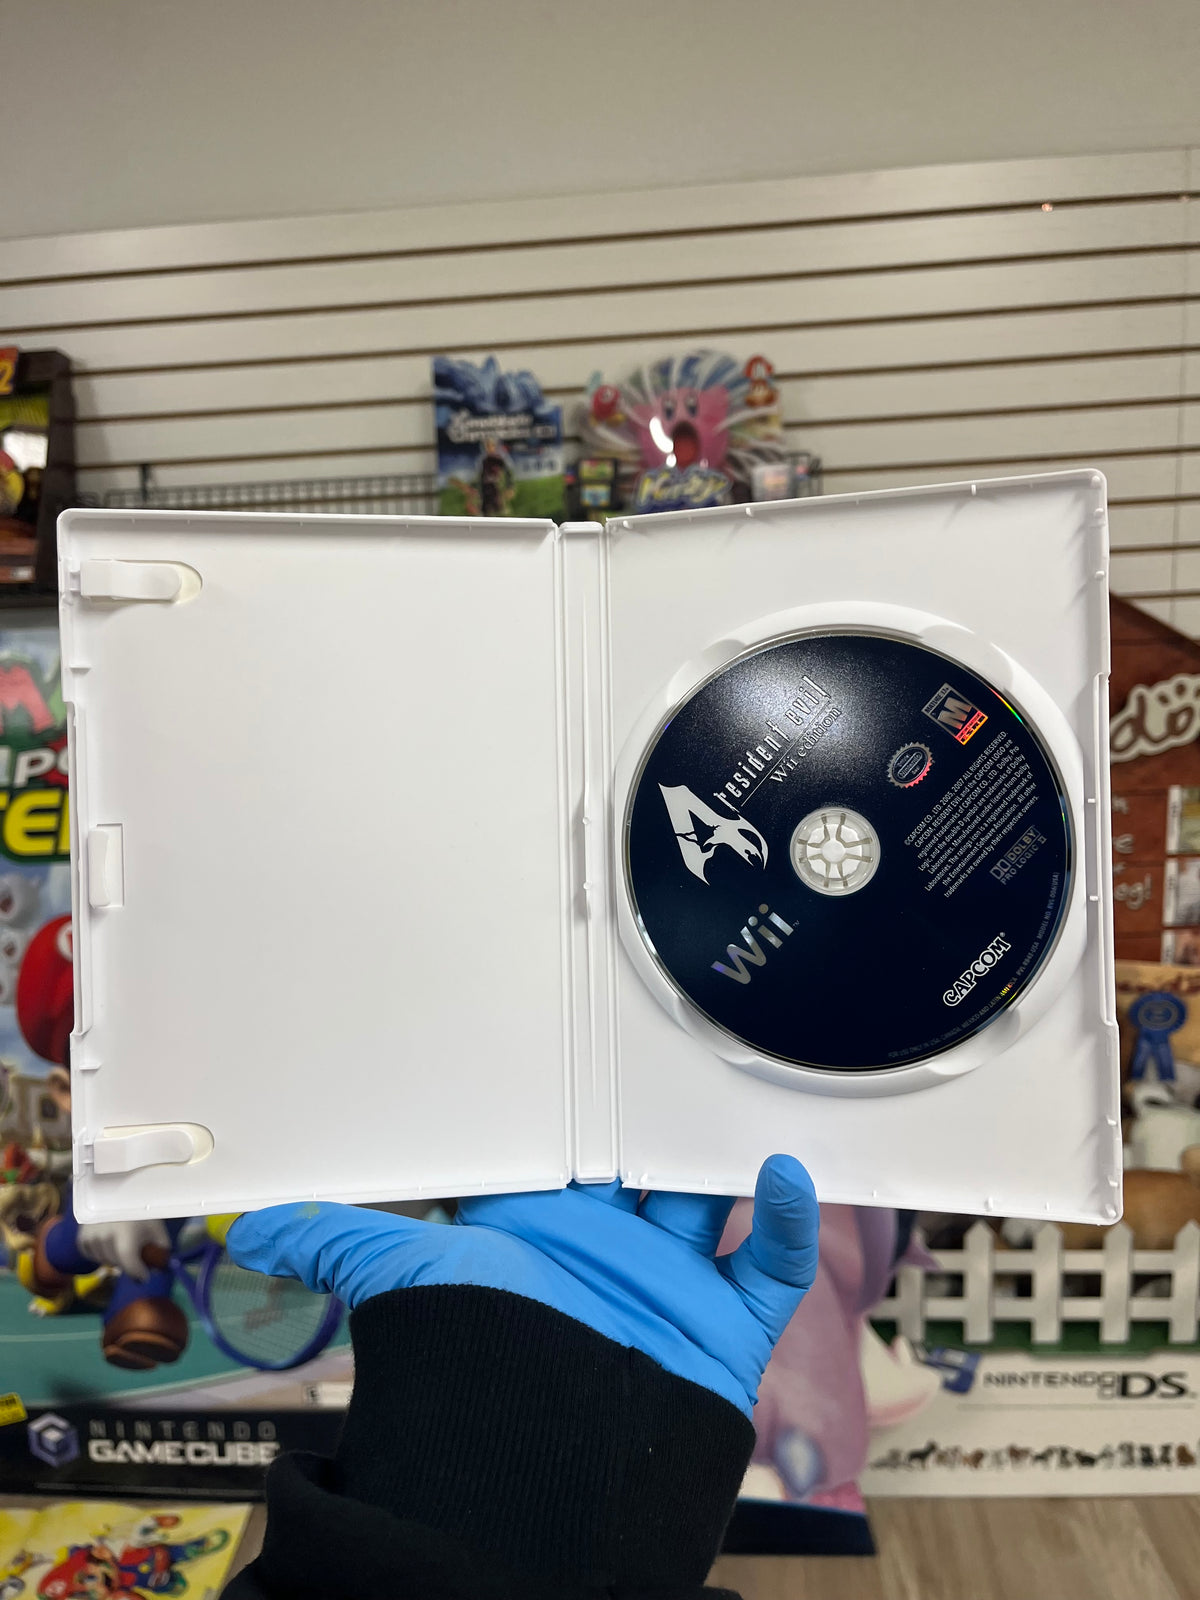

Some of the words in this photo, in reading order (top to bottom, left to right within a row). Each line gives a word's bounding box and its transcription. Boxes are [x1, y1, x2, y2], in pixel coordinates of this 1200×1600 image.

[713, 720, 791, 813] resident
[785, 675, 831, 726] evil
[769, 757, 798, 784] Wii
[798, 707, 842, 758] edition
[937, 697, 972, 730] M
[917, 834, 938, 859] registered
[935, 812, 960, 837] trademarks
[958, 805, 964, 813] of
[961, 786, 981, 808] CAPCOM
[1008, 745, 1019, 755] Pro
[931, 804, 953, 827] RESIDENT
[950, 795, 962, 807] EVIL
[959, 785, 970, 797] and
[967, 779, 977, 788] the
[973, 758, 994, 780] CAPCOM
[991, 746, 1005, 761] LOGO
[1003, 739, 1012, 748] are
[951, 777, 964, 792] 2007
[962, 770, 972, 780] ALL
[968, 753, 986, 772] RIGHTS
[951, 814, 981, 847] Manufactured
[978, 802, 993, 817] under
[989, 787, 1007, 804] license
[1003, 776, 1017, 788] from
[1013, 762, 1030, 777] Dolby
[917, 857, 933, 871] Logic,
[929, 847, 940, 858] and
[937, 840, 946, 849] the
[962, 803, 979, 822] symbol
[976, 797, 986, 806] are
[983, 772, 1007, 798] trademarks
[1005, 765, 1012, 774] of
[1009, 753, 1025, 768] Dolby
[941, 876, 951, 886] the
[948, 846, 979, 878] Entertainment
[975, 828, 995, 848] Software
[1016, 793, 1025, 803] All
[1023, 782, 1036, 796] other
[943, 872, 968, 897] trademarks
[965, 865, 974, 873] are
[972, 849, 988, 866] owned
[990, 833, 1002, 845] their
[1001, 811, 1023, 835] respective
[1021, 795, 1038, 812] owners.
[947, 855, 959, 864] The
[956, 839, 972, 856] ratings
[969, 830, 981, 841] icon
[986, 799, 1008, 824] registered
[1005, 777, 1028, 801] trademark
[1026, 770, 1033, 779] of
[1006, 829, 1035, 861] DOLBY
[999, 867, 1016, 885] PRO
[1015, 844, 1038, 868] LOGIC
[711, 904, 793, 984] Wii
[942, 936, 1011, 1006] CAPCOM
[983, 1371, 1117, 1397] NINTENDO
[1120, 1371, 1189, 1399] DS
[88, 1419, 277, 1441] NINTENDO
[88, 1439, 281, 1466] GAMECUBE
